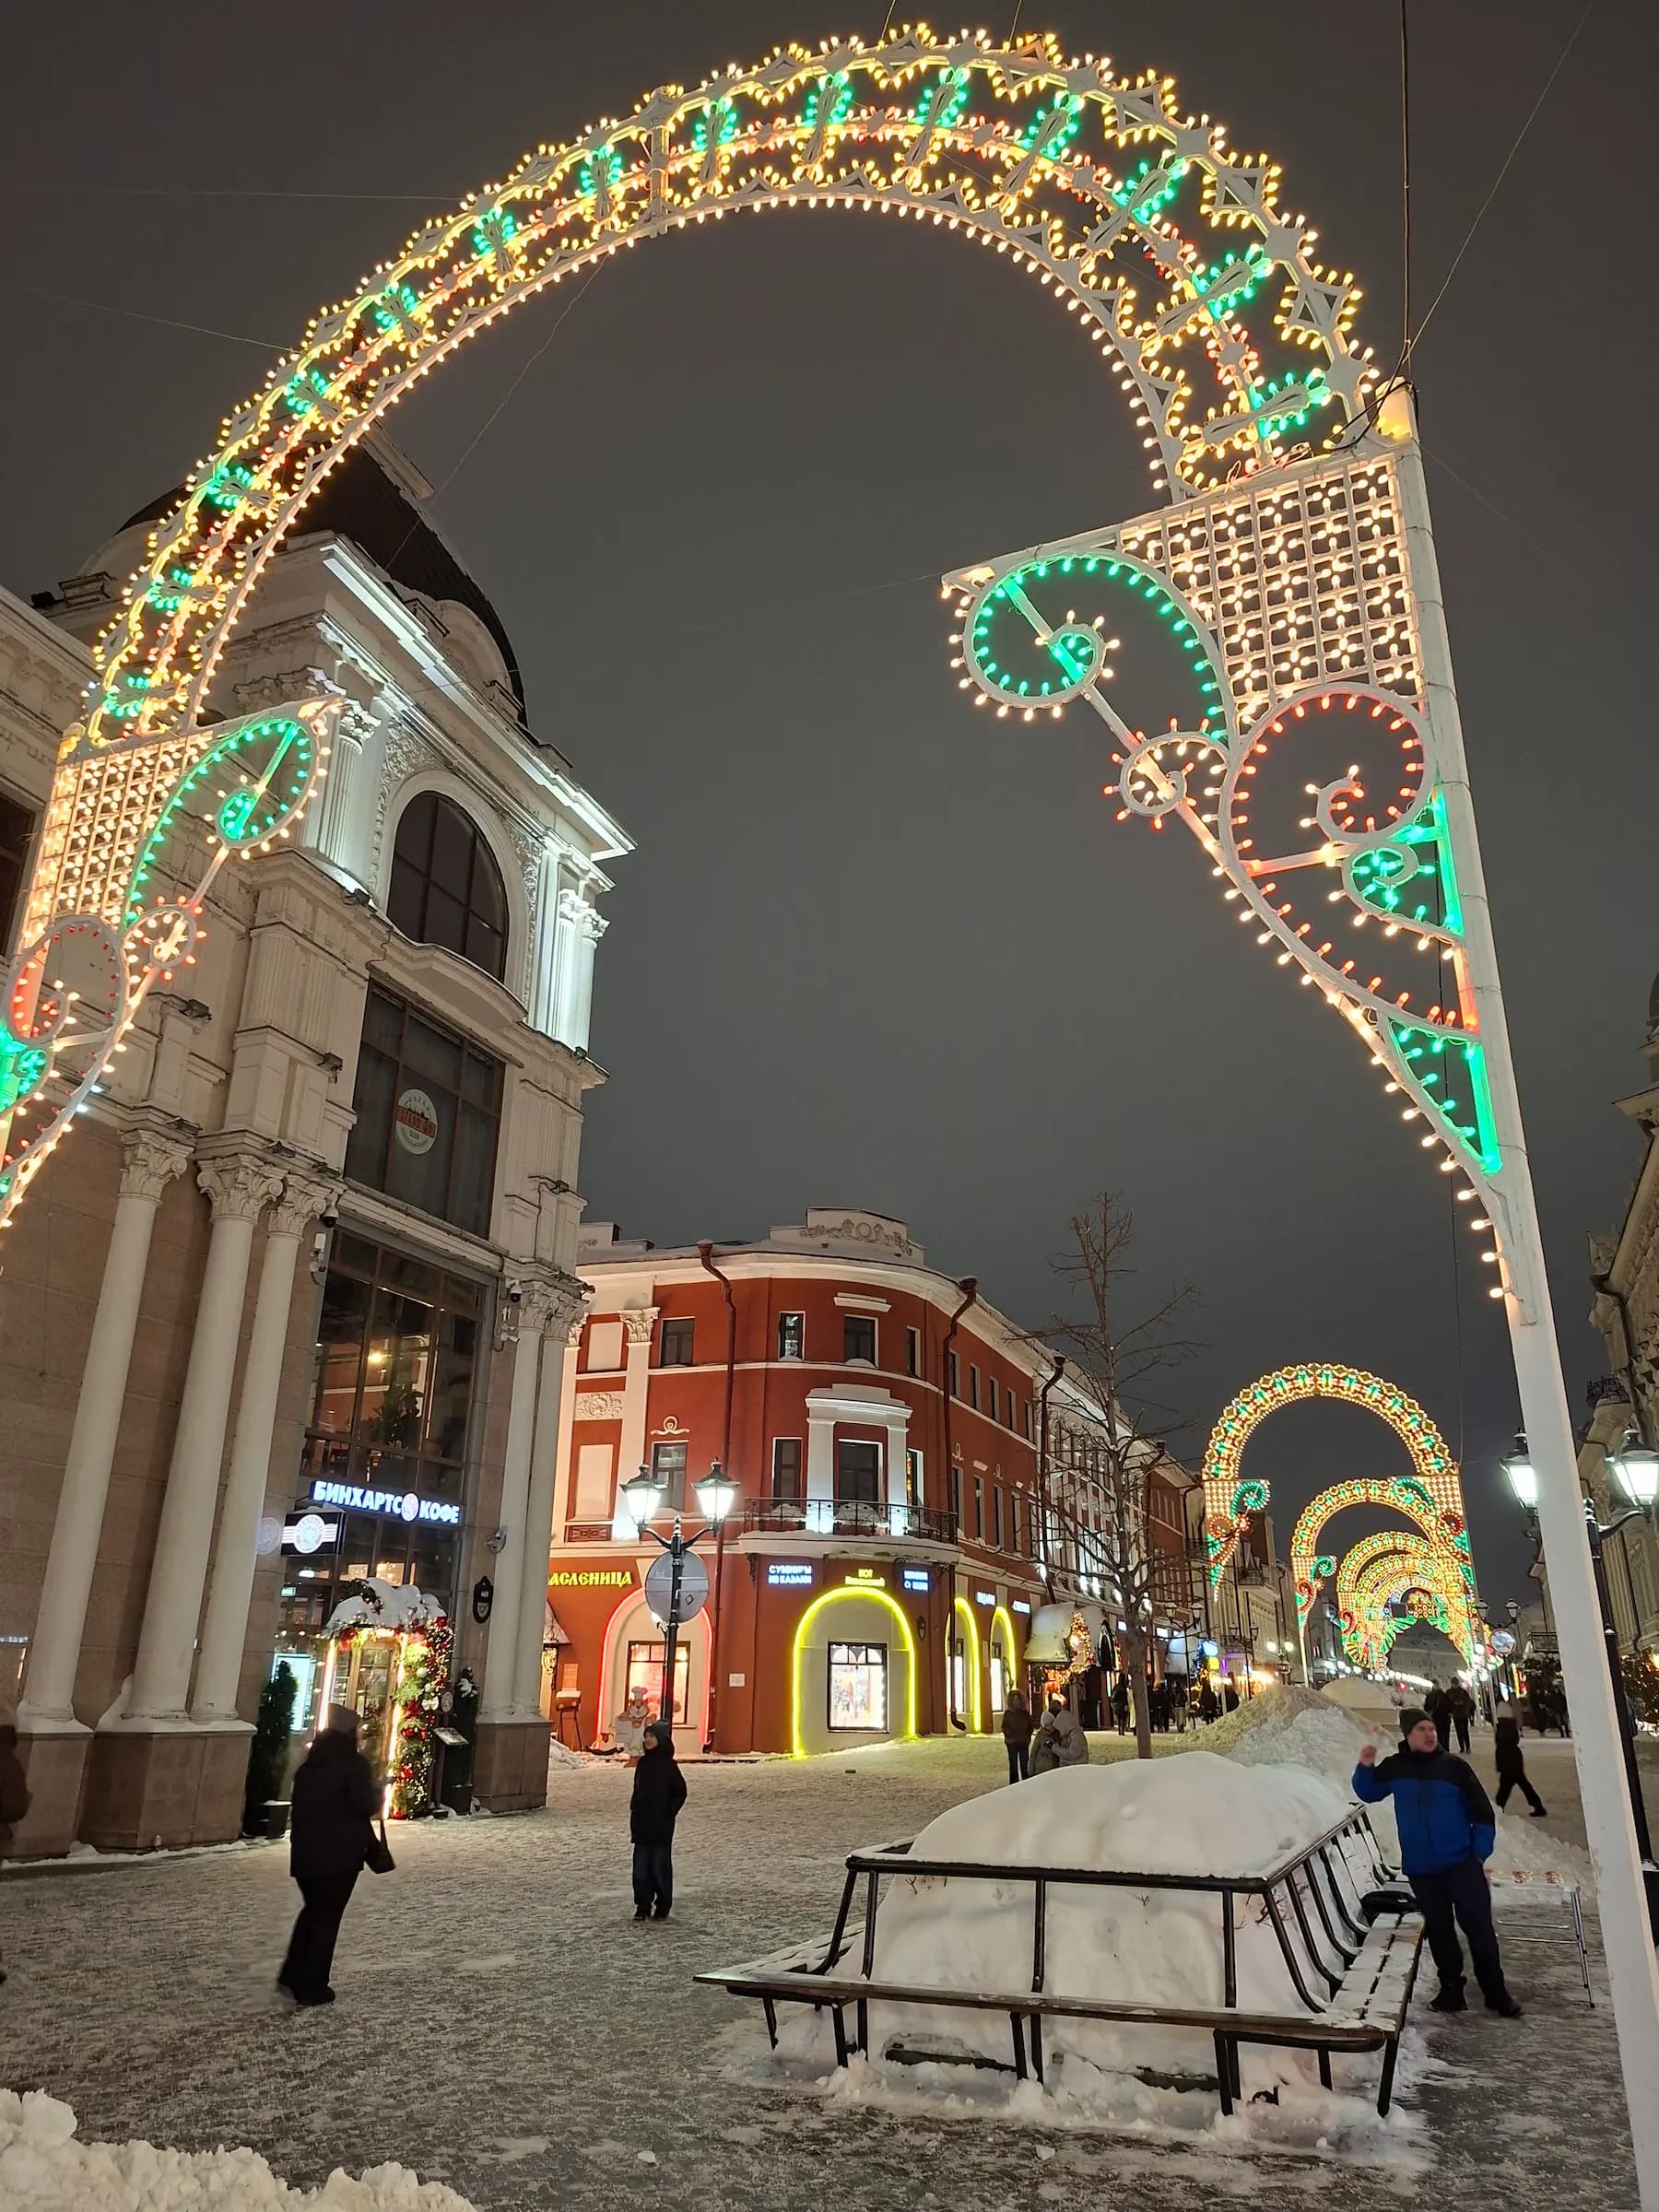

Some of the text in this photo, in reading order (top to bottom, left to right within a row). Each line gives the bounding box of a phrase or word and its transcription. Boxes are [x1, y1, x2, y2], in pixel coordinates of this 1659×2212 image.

[313, 1480, 460, 1524] БИНХАРТС КОФЕ
[547, 1571, 633, 1588] АСЛЕНИЦА
